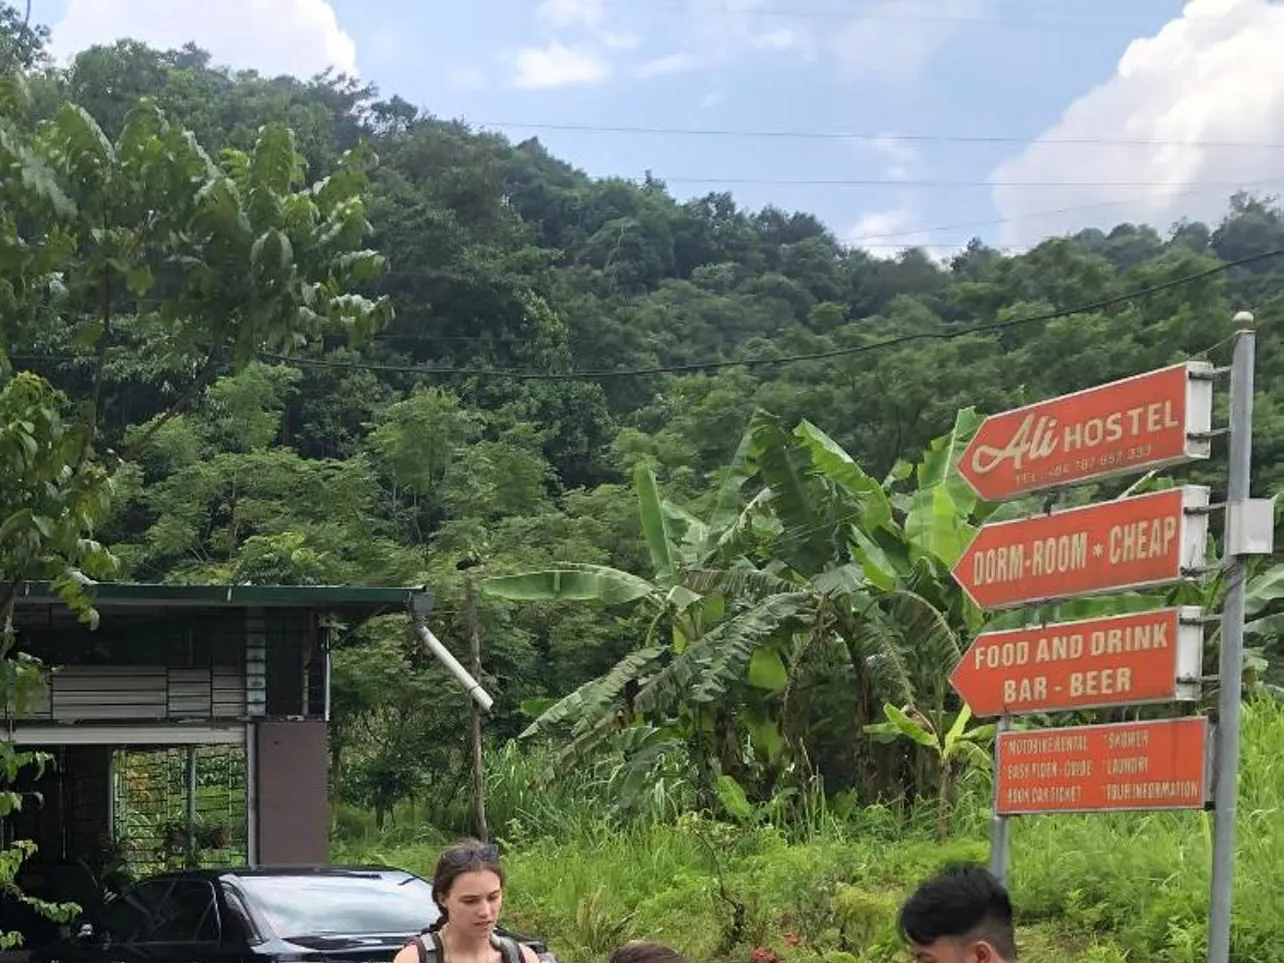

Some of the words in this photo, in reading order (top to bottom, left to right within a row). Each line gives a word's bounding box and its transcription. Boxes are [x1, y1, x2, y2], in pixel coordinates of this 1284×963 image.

[972, 412, 1060, 474] Ali
[1064, 400, 1179, 453] HOSTEL
[973, 531, 1087, 587] DORM-ROOM
[1109, 516, 1177, 564] CHEAP
[974, 641, 1029, 670] FOOD
[1036, 634, 1084, 663] AND
[1090, 622, 1168, 657] DRINK
[1004, 675, 1047, 703] BAR
[1070, 667, 1132, 697] BEER
